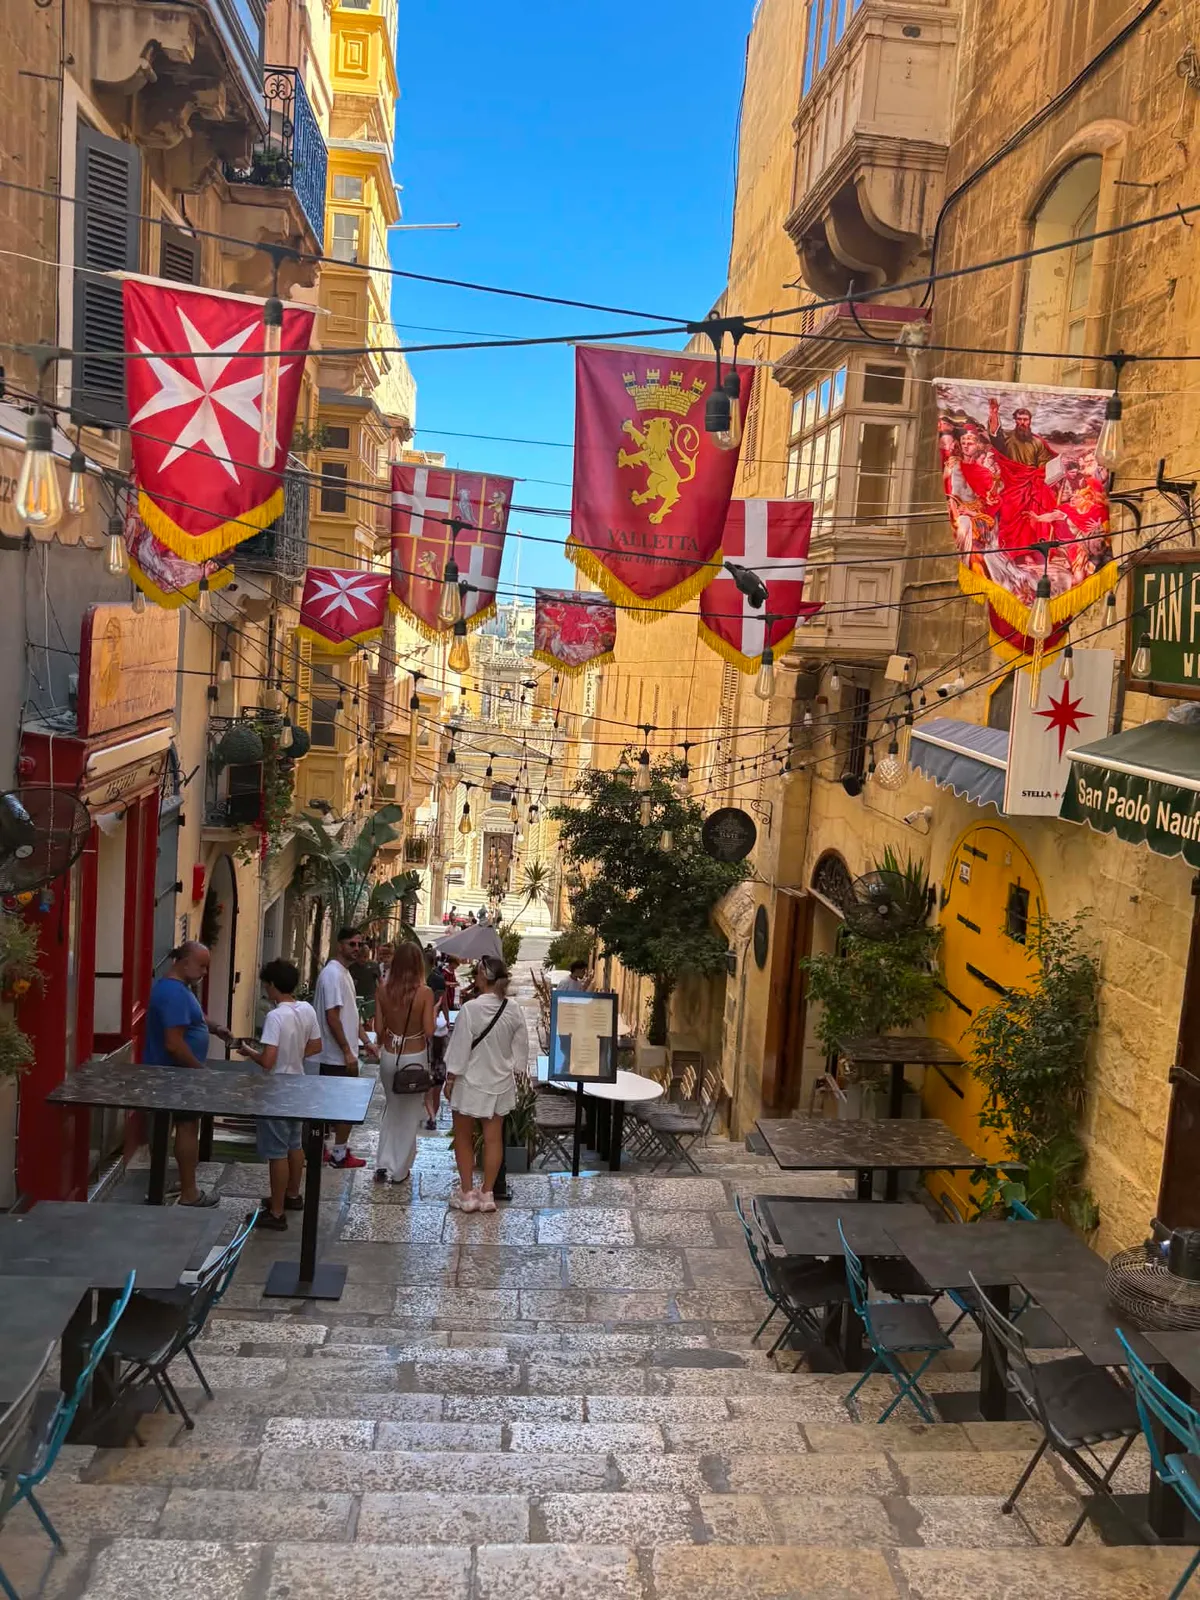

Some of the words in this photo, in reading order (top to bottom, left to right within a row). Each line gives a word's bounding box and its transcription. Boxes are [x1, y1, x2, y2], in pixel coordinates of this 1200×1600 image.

[608, 528, 699, 552] VALLETTA
[1144, 571, 1183, 642] SAN
[1021, 790, 1051, 798] STELLA
[1078, 777, 1103, 810] San
[1105, 786, 1151, 825] Paolo
[1156, 800, 1200, 842] Nauf
